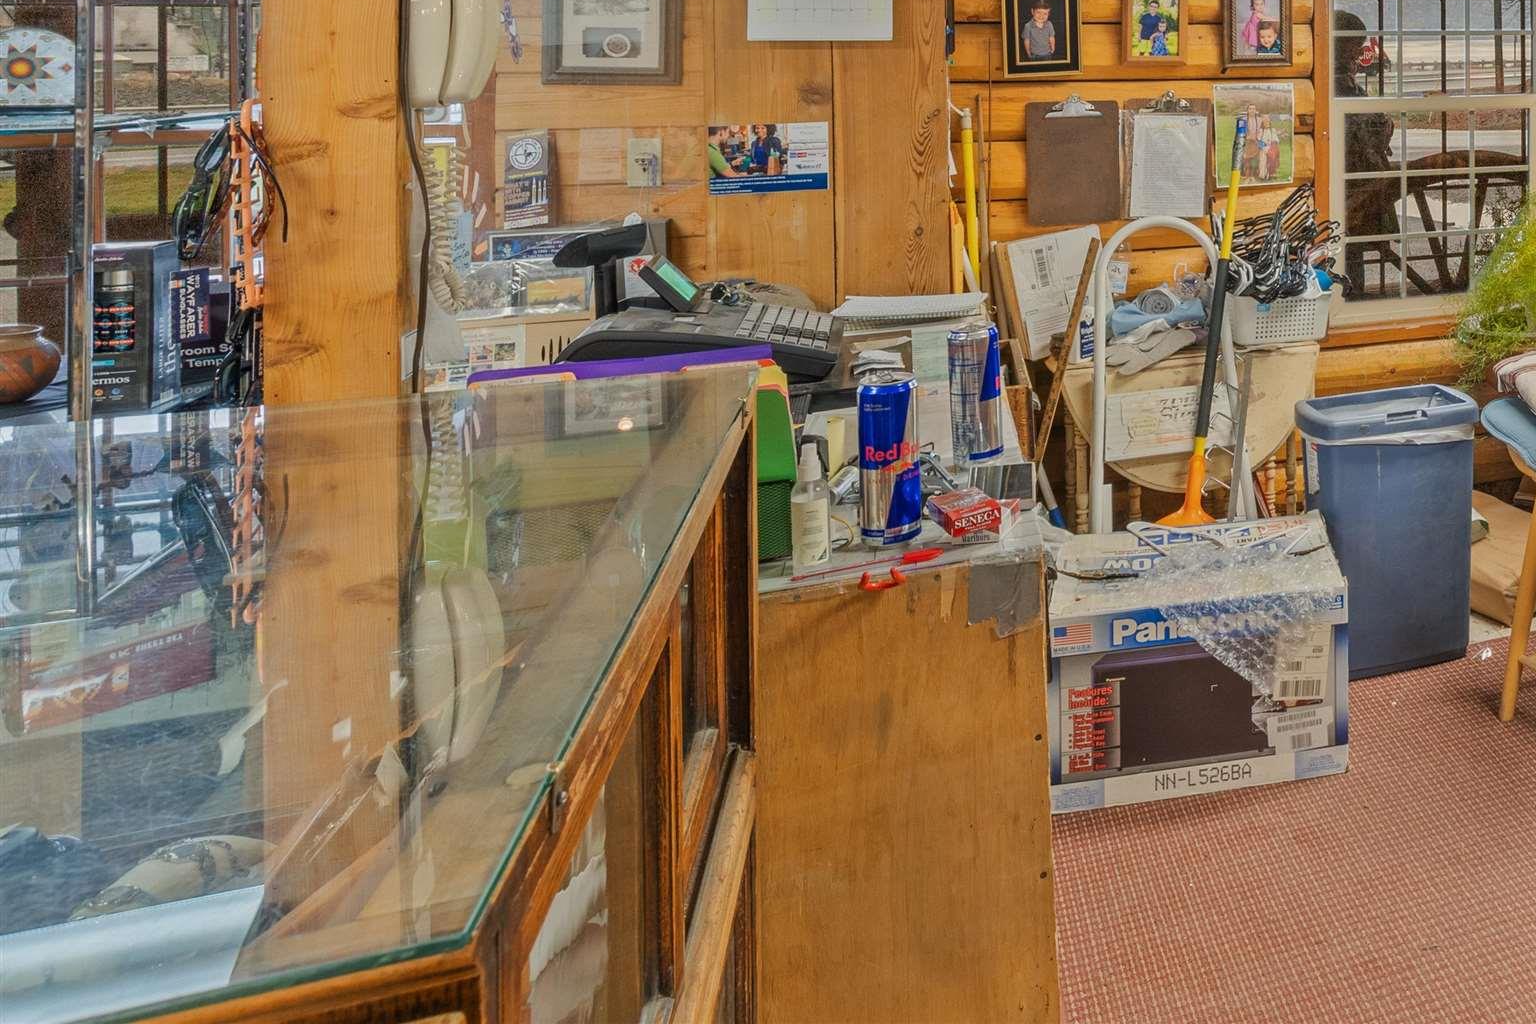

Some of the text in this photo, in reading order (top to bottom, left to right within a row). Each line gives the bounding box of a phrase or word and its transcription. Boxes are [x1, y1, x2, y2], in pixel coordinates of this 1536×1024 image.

[179, 288, 187, 340] SUNGLASSES
[186, 275, 196, 339] WAYFARER
[865, 443, 898, 462] Red
[954, 508, 1000, 529] SENECA
[1069, 686, 1113, 696] Features
